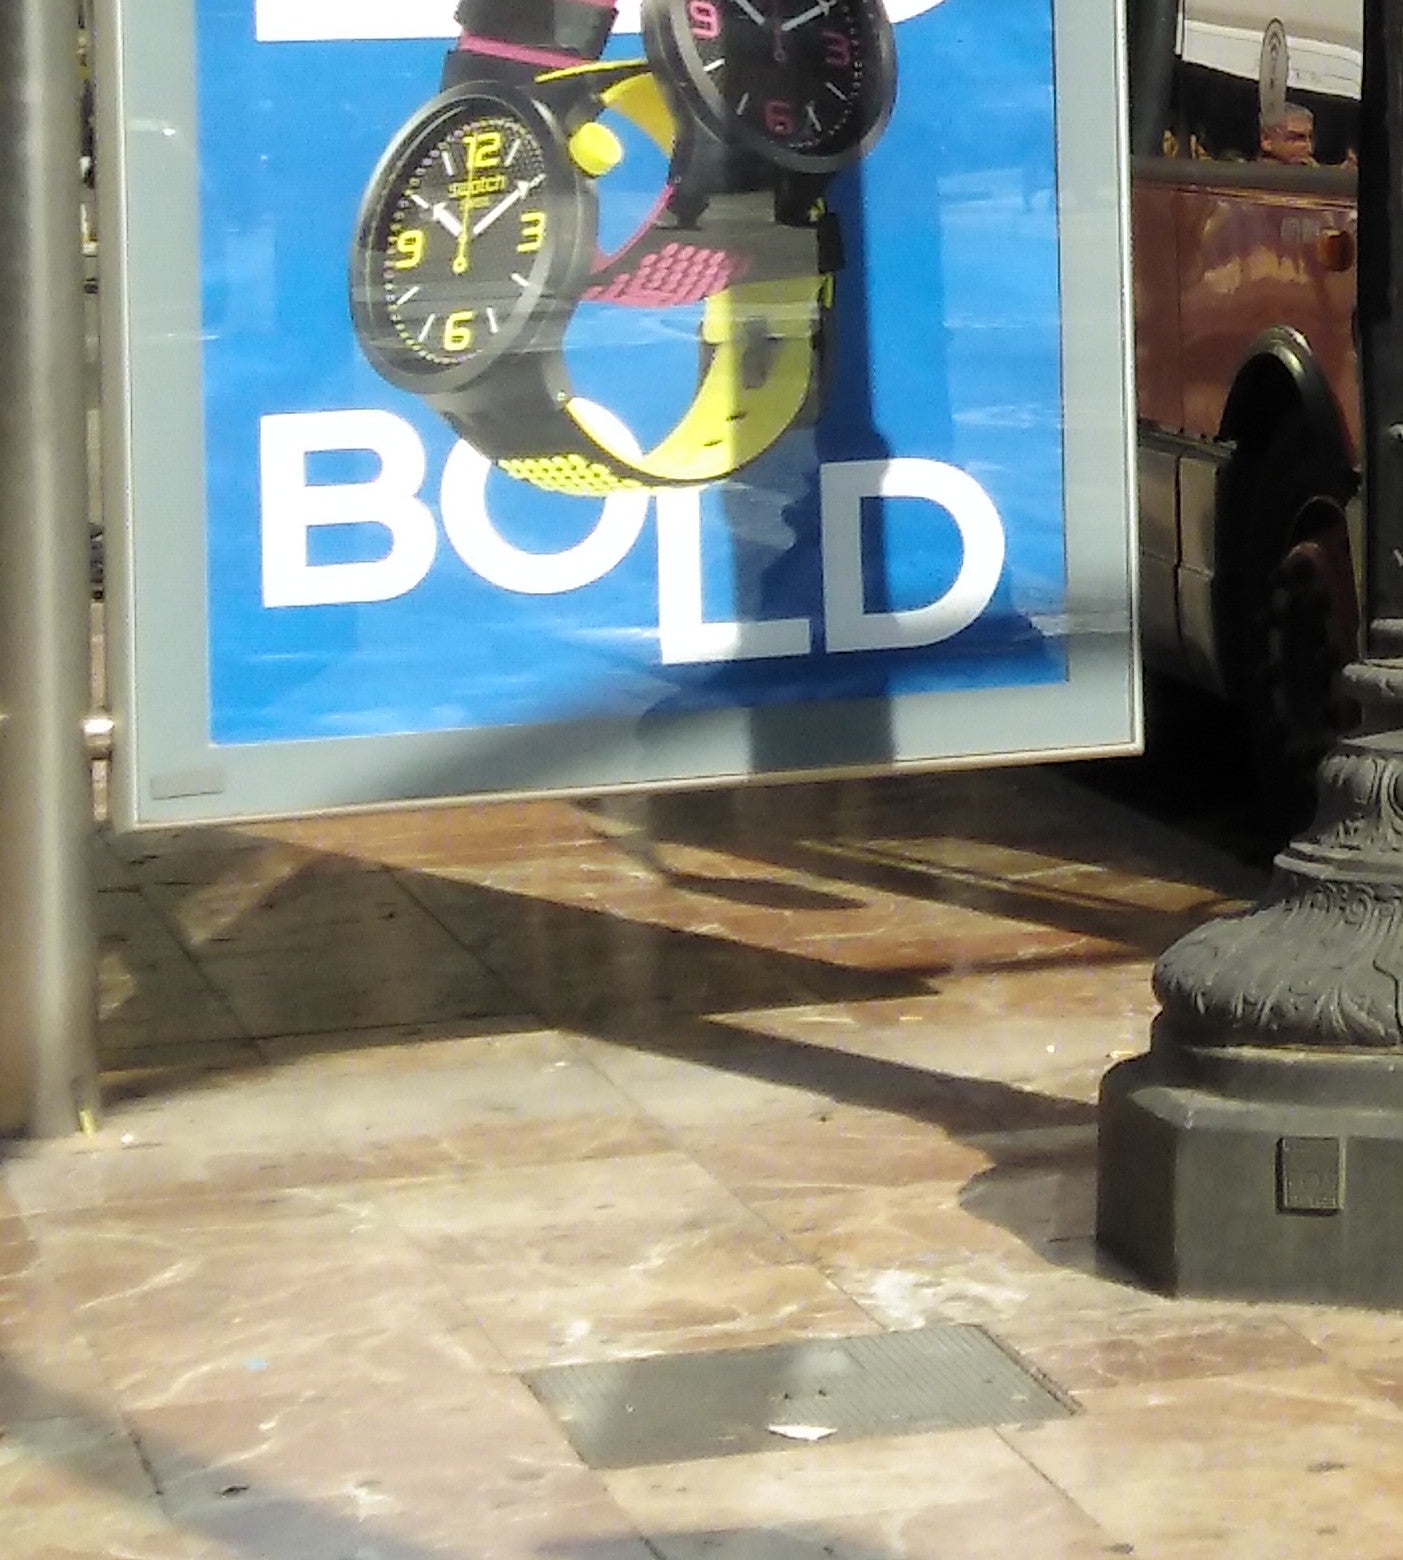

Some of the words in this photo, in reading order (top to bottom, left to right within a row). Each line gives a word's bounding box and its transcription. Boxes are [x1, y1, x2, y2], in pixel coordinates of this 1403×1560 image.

[821, 30, 850, 66] 3
[764, 98, 795, 136] 6
[461, 130, 502, 169] 12
[394, 229, 425, 269] 9
[516, 211, 546, 254] 3
[442, 310, 476, 351] 6
[259, 408, 1006, 665] BOLD
